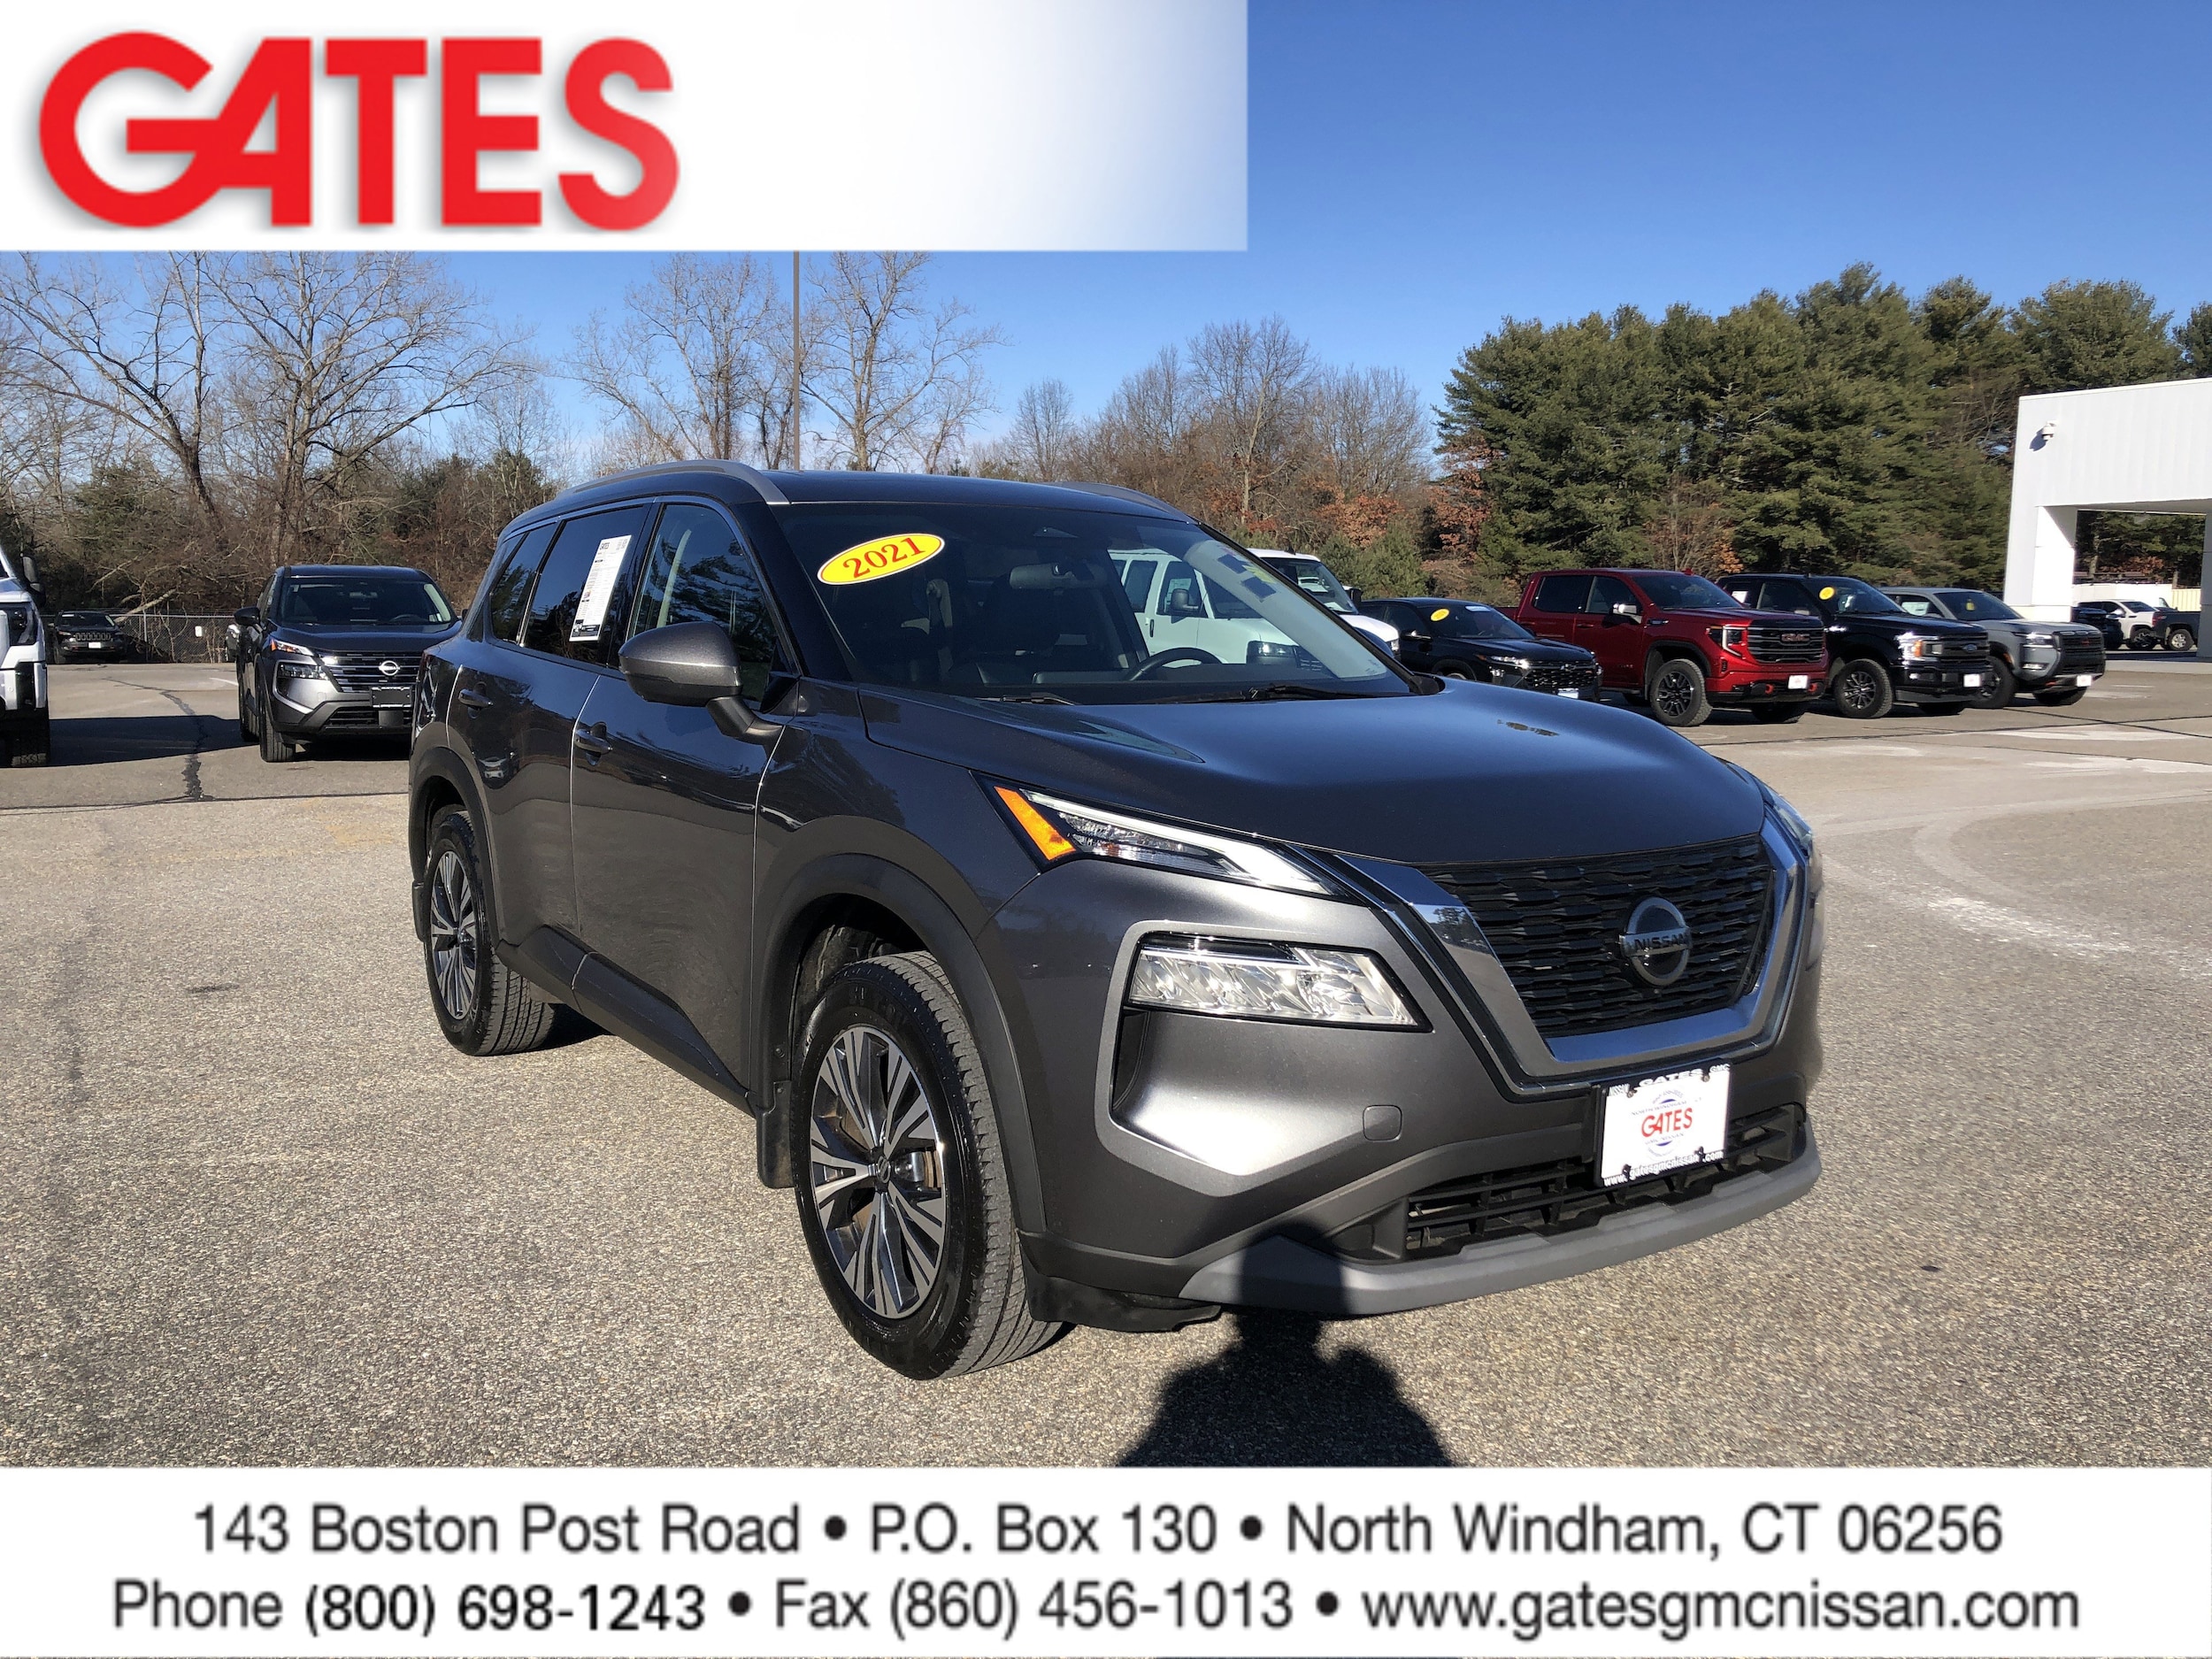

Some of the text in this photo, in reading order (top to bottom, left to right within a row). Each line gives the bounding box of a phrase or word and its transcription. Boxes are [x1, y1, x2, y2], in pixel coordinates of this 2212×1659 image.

[843, 537, 926, 579] 2021
[1634, 932, 1686, 951] NISSAN
[1639, 1068, 1704, 1087] GATES
[1641, 1107, 1694, 1138] GATES
